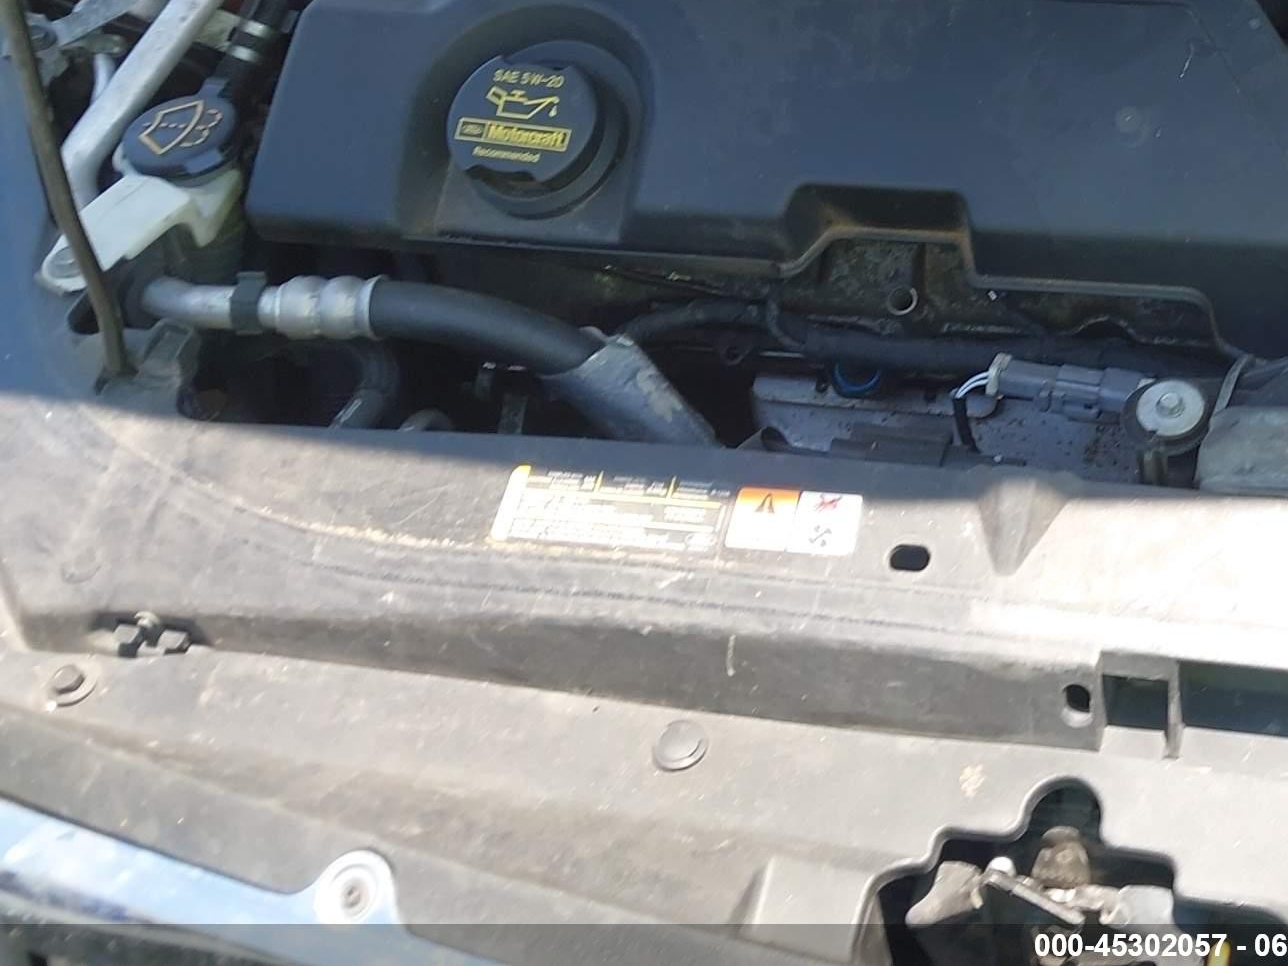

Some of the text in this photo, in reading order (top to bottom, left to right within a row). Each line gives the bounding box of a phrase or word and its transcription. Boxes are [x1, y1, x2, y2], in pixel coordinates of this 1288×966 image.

[493, 69, 565, 88] SAE 5W-20
[486, 123, 565, 147] Motorcraft
